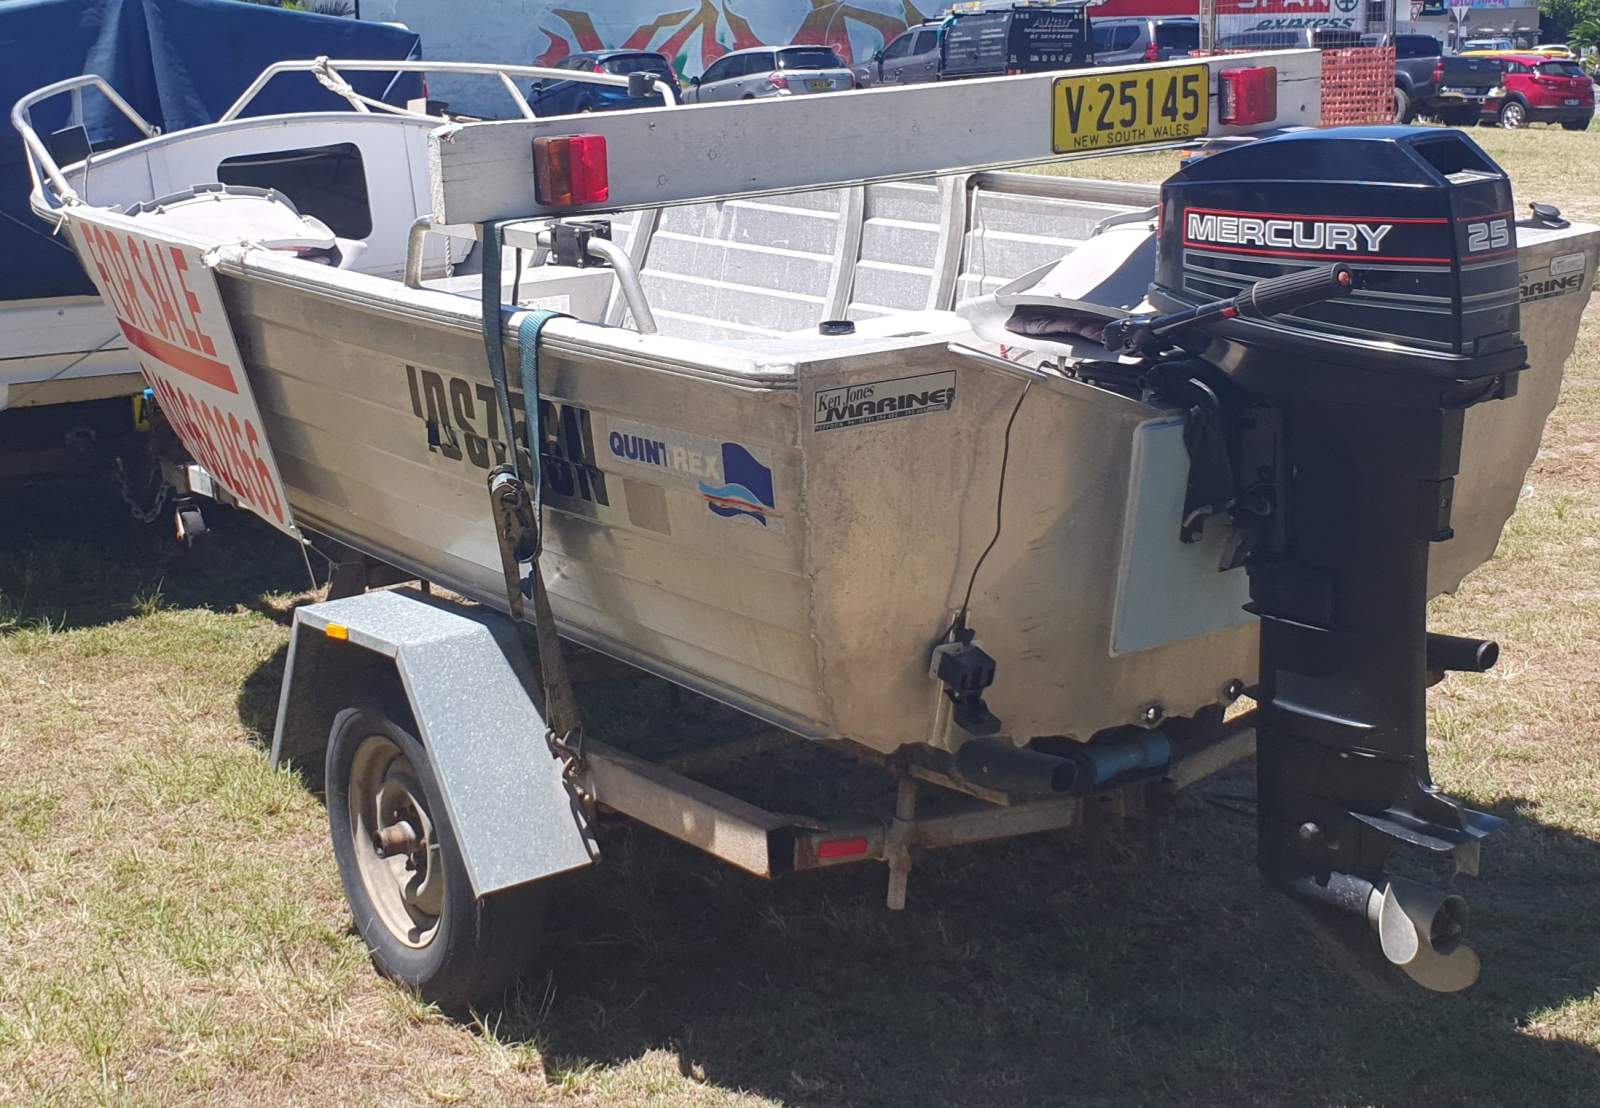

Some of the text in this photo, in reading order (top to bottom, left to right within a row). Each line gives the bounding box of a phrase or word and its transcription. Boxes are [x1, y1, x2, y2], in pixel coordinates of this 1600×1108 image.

[1257, 17, 1356, 30] express
[1073, 123, 1190, 148] NEW SOUTH WALES
[1187, 213, 1509, 252] MERCURY 25
[79, 221, 218, 358] FOR SALE
[1519, 274, 1578, 297] ARINE
[818, 384, 875, 413] Ken Jones
[824, 388, 947, 422] MARINE
[608, 431, 722, 481] QUINTREX
